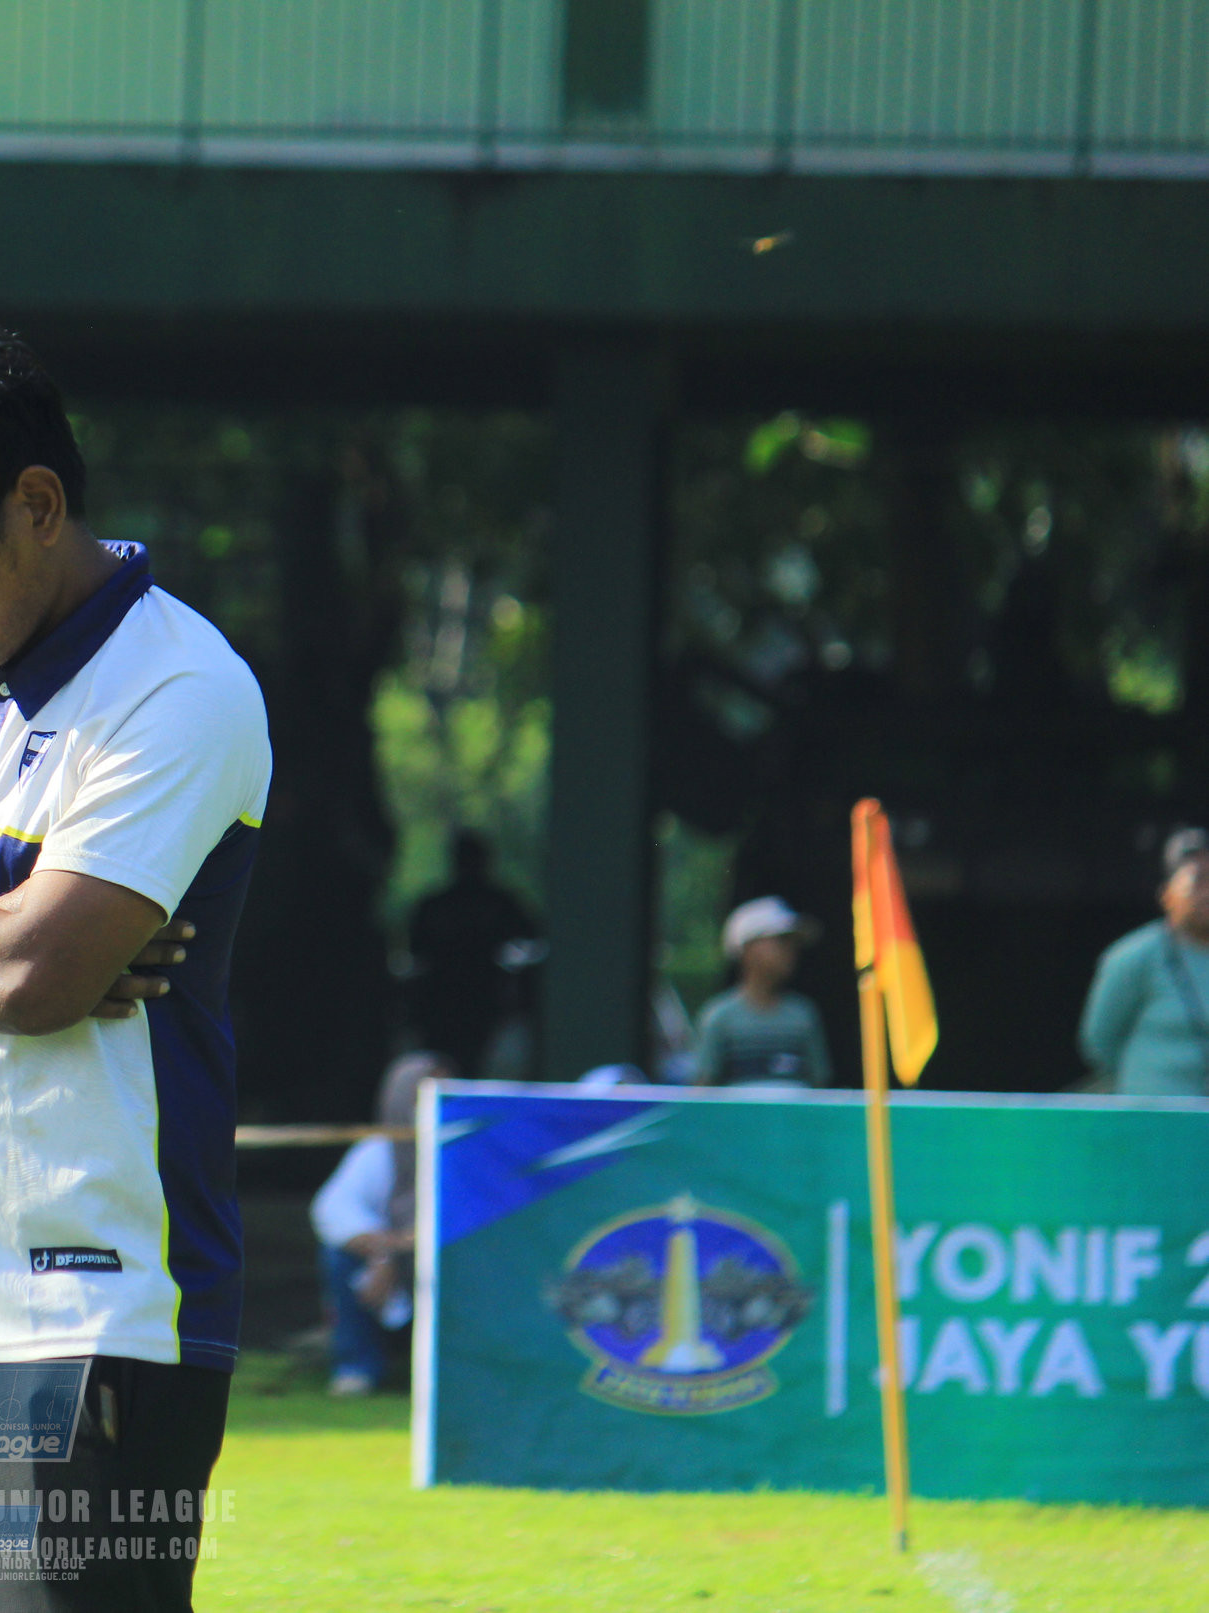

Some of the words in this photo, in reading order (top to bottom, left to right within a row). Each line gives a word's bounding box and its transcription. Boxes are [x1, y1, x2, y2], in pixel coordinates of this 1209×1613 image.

[892, 1222, 1162, 1306] YONIF
[873, 1314, 1103, 1397] JAYA
[1126, 1319, 1209, 1401] Y
